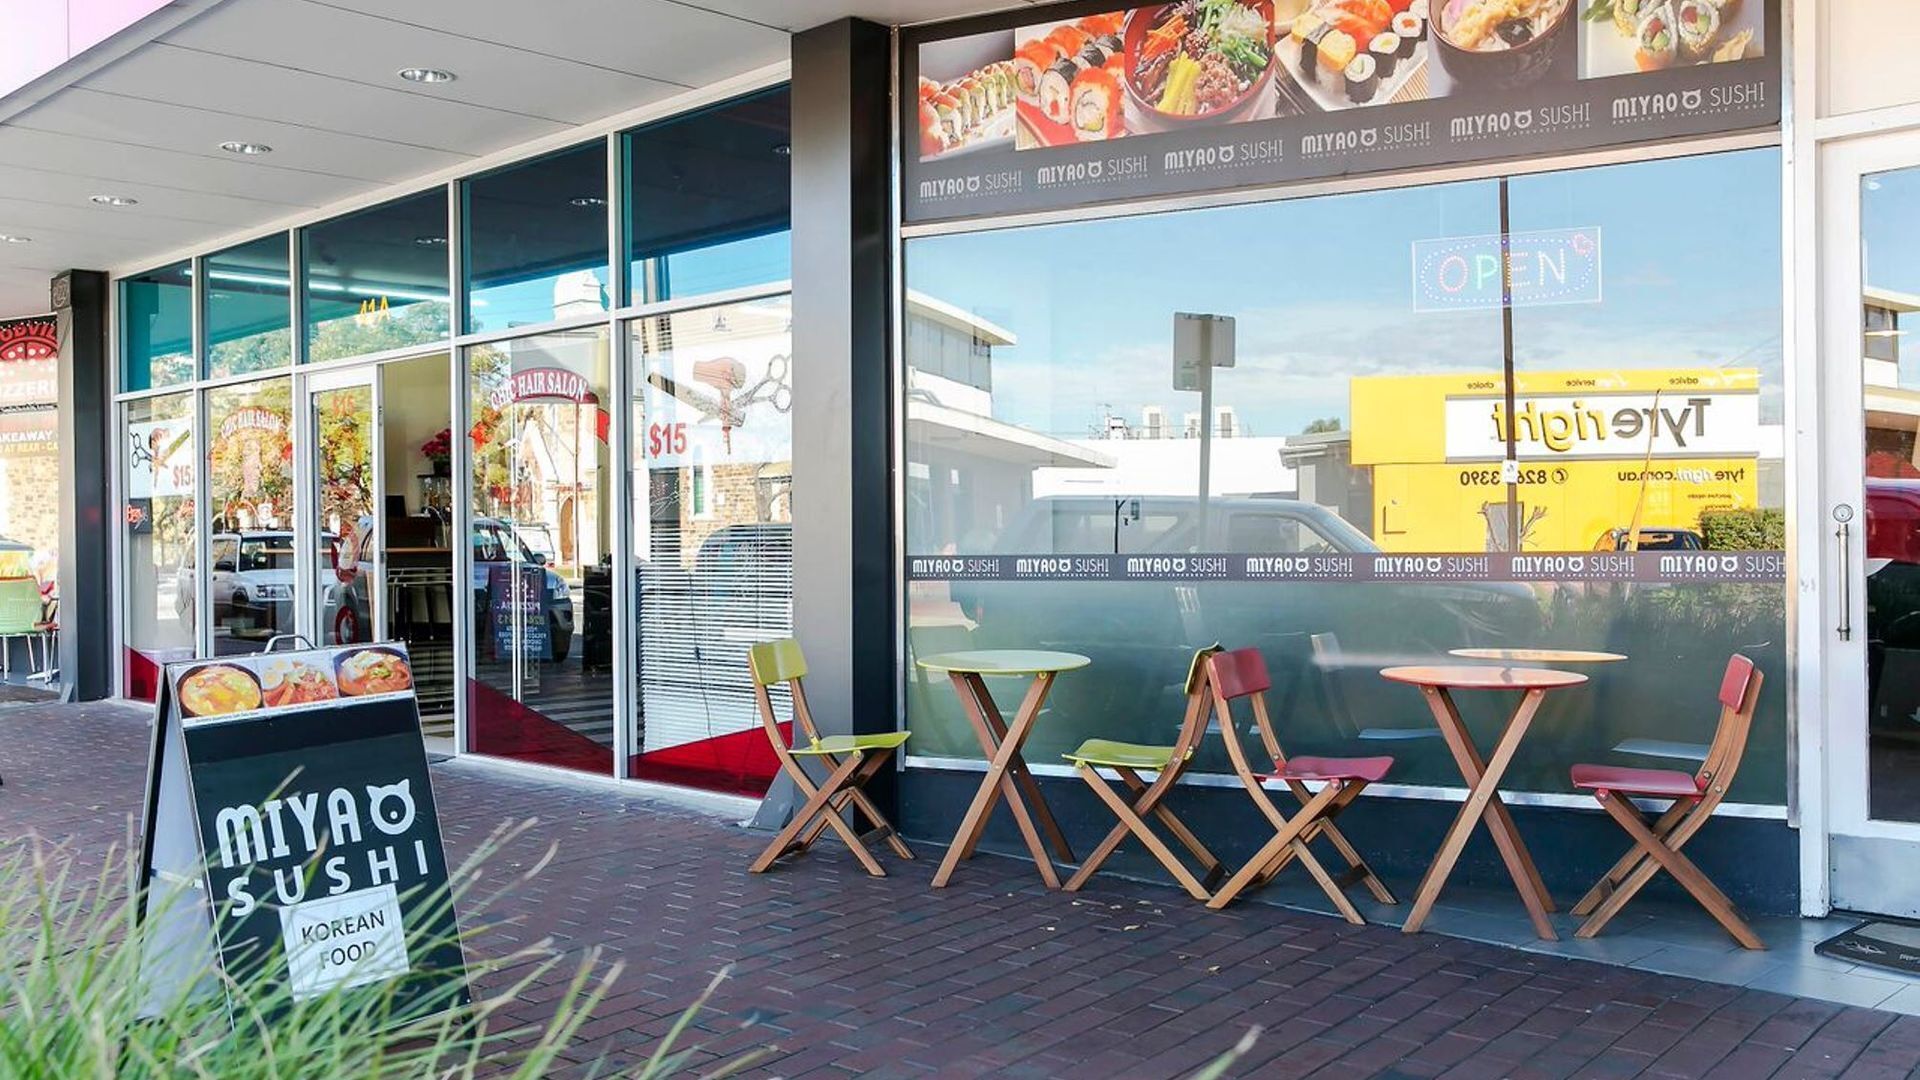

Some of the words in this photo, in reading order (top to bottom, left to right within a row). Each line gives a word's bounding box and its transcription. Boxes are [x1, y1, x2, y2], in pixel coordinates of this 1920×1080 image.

[1612, 92, 1678, 119] MIYAO
[1710, 82, 1765, 106] SUSHI
[1451, 112, 1511, 137] MIYAO
[1539, 102, 1591, 126] SUSHI
[1301, 130, 1357, 154] MIYAO
[1384, 121, 1430, 144] SUSHI
[1038, 162, 1085, 184] MIYAO
[1108, 155, 1148, 175] SUSHI
[1164, 147, 1216, 170] MIYAO
[1240, 140, 1283, 160] SUSHI
[920, 177, 964, 198] MIYAO
[985, 169, 1022, 190] SUSHI
[1439, 249, 1566, 292] OPEN
[518, 372, 547, 396] HAIR
[547, 371, 588, 403] SALON
[650, 422, 687, 459] $15
[173, 465, 191, 489] $15
[913, 559, 950, 573] MIYAO
[968, 559, 1000, 573] SUSHI
[1016, 559, 1057, 572] MIYAO
[1075, 558, 1109, 572] SUSHI
[1127, 558, 1171, 572] MIYAO
[1191, 558, 1227, 572] SUSHI
[1246, 557, 1293, 572] MIYAO
[1314, 557, 1352, 572] SUSHI
[1375, 557, 1424, 573] MIYAO
[1447, 557, 1488, 573] SUSHI
[1512, 556, 1565, 573] MIYAO
[1590, 556, 1634, 572] SUSHI
[1660, 556, 1718, 573] MIYAO
[215, 778, 416, 868] MIYAO
[227, 840, 429, 917] SUSHI
[301, 909, 386, 944] KOREAN
[319, 940, 377, 970] FOOD
